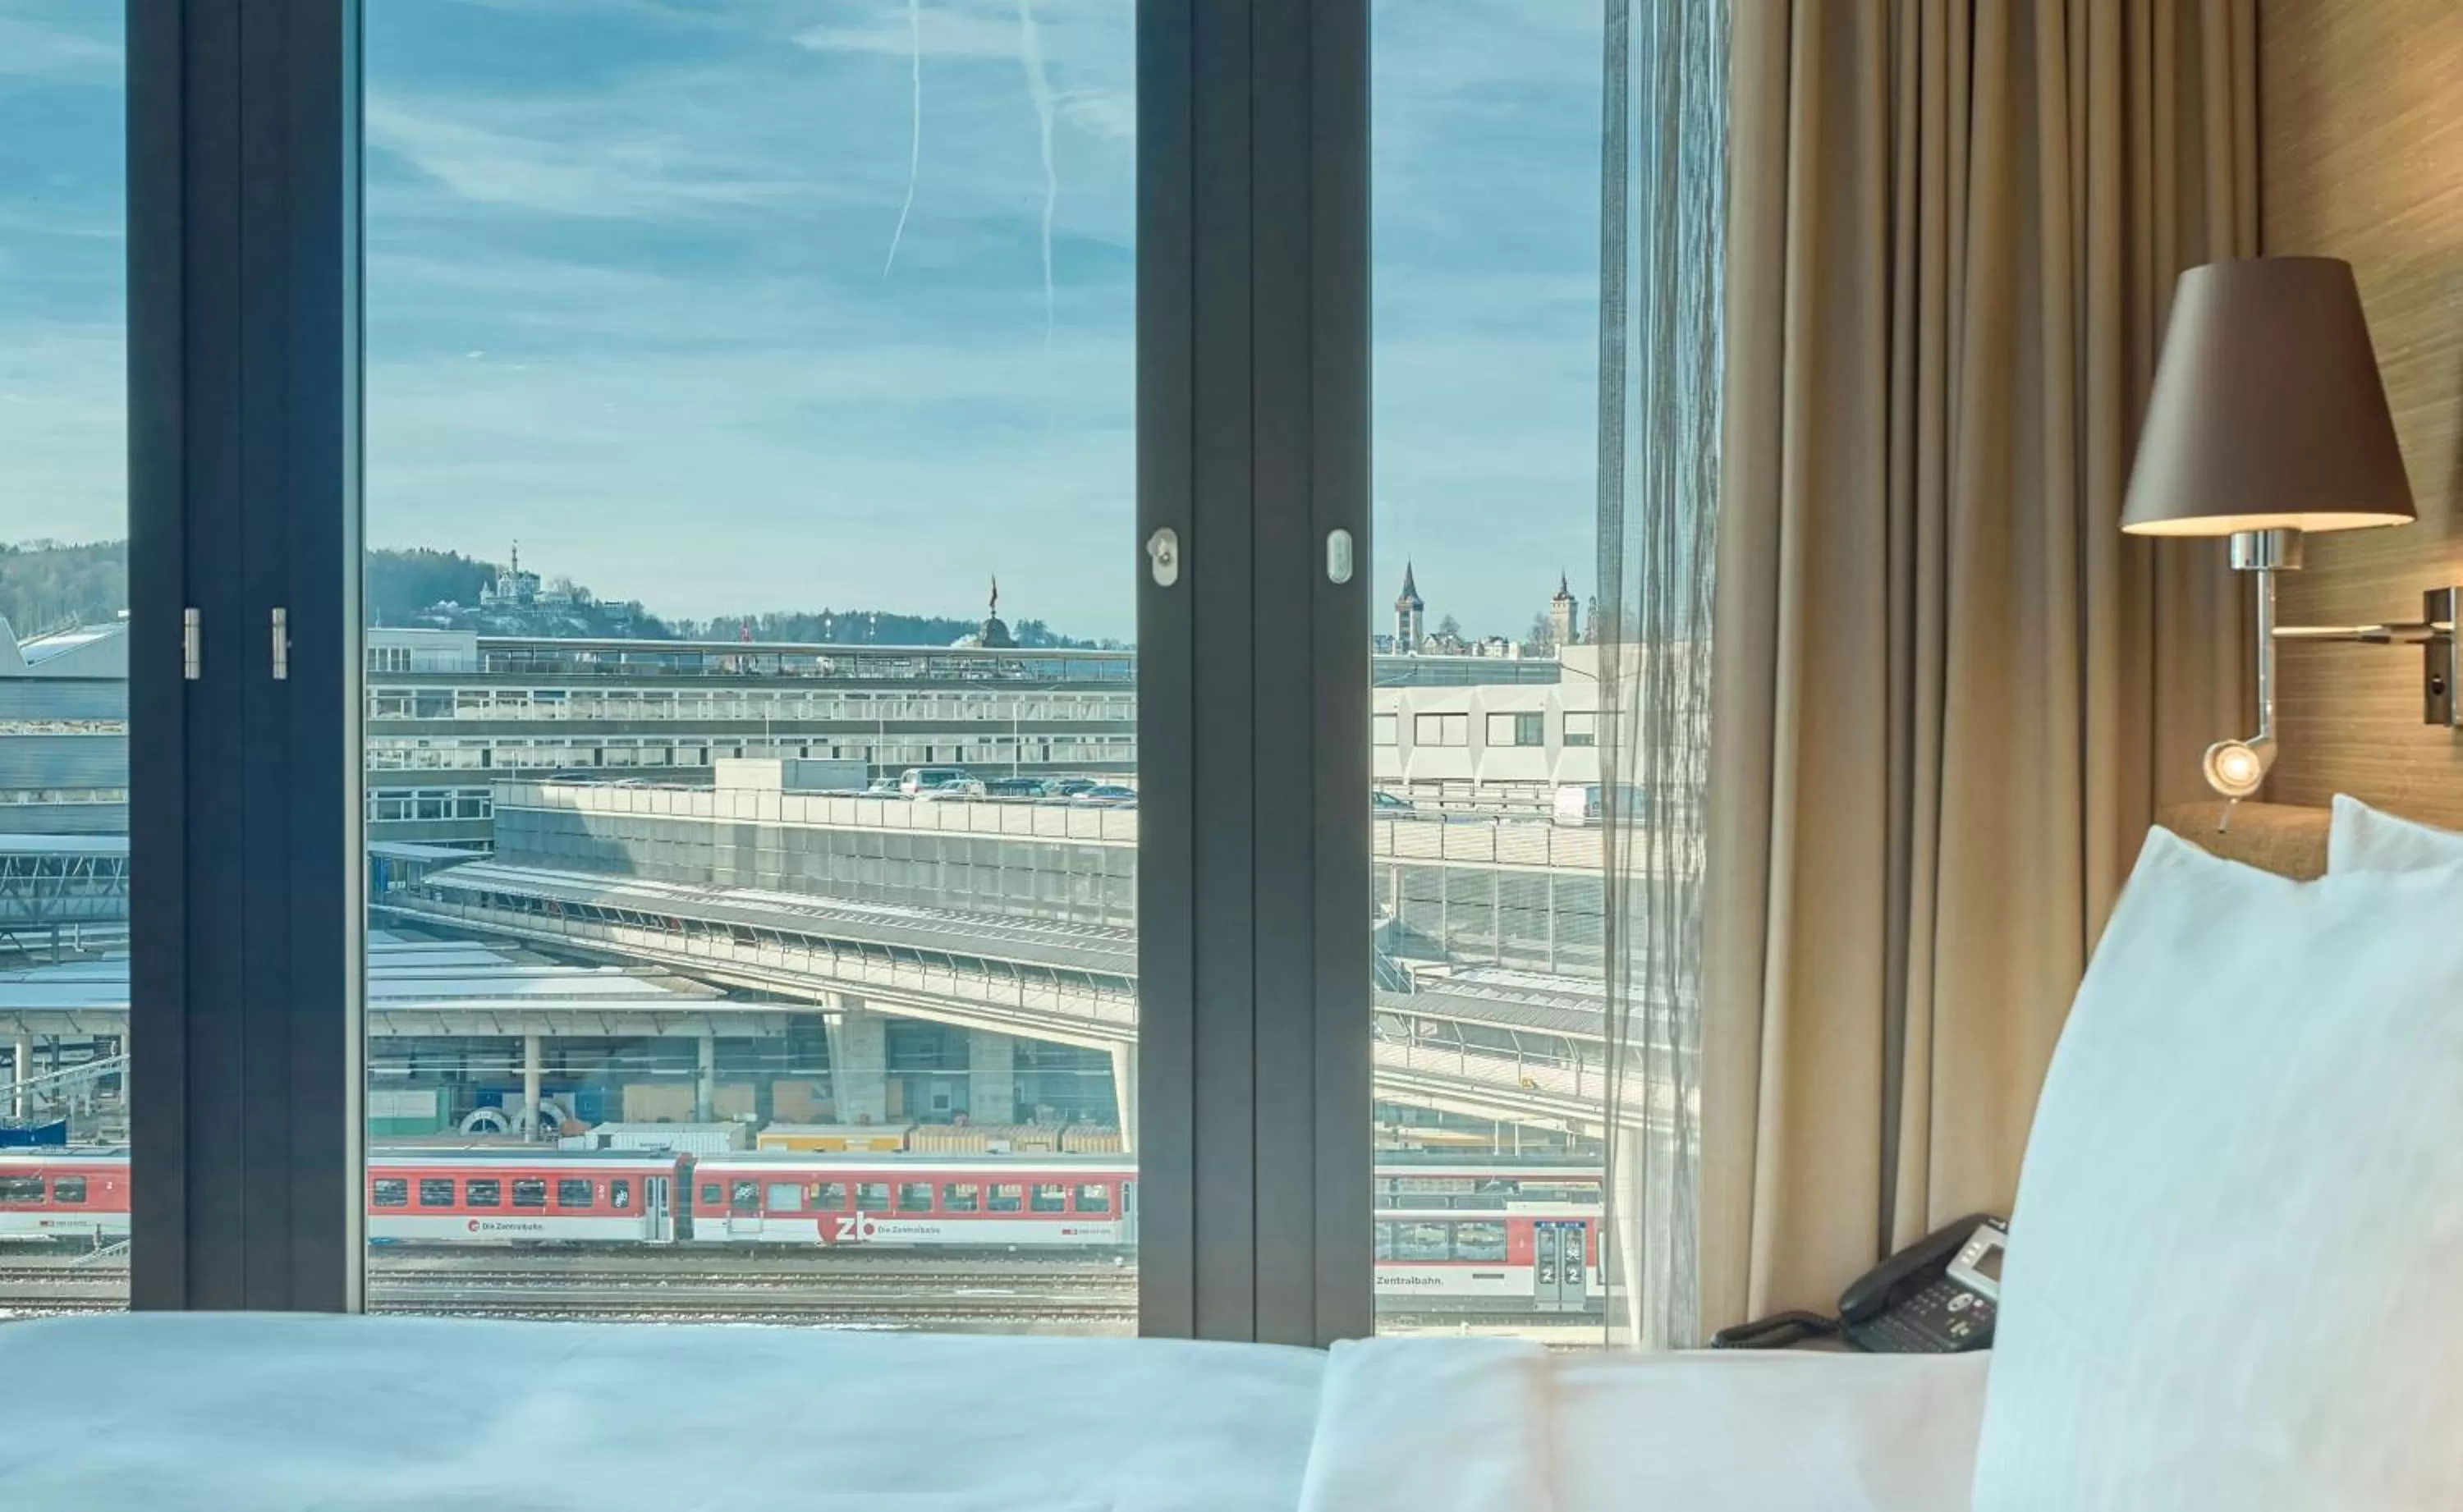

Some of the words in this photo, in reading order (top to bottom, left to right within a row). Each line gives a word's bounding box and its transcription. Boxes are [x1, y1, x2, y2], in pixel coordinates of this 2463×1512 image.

[835, 1211, 877, 1241] zb
[1543, 1267, 1551, 1281] 2
[1569, 1267, 1577, 1281] 2
